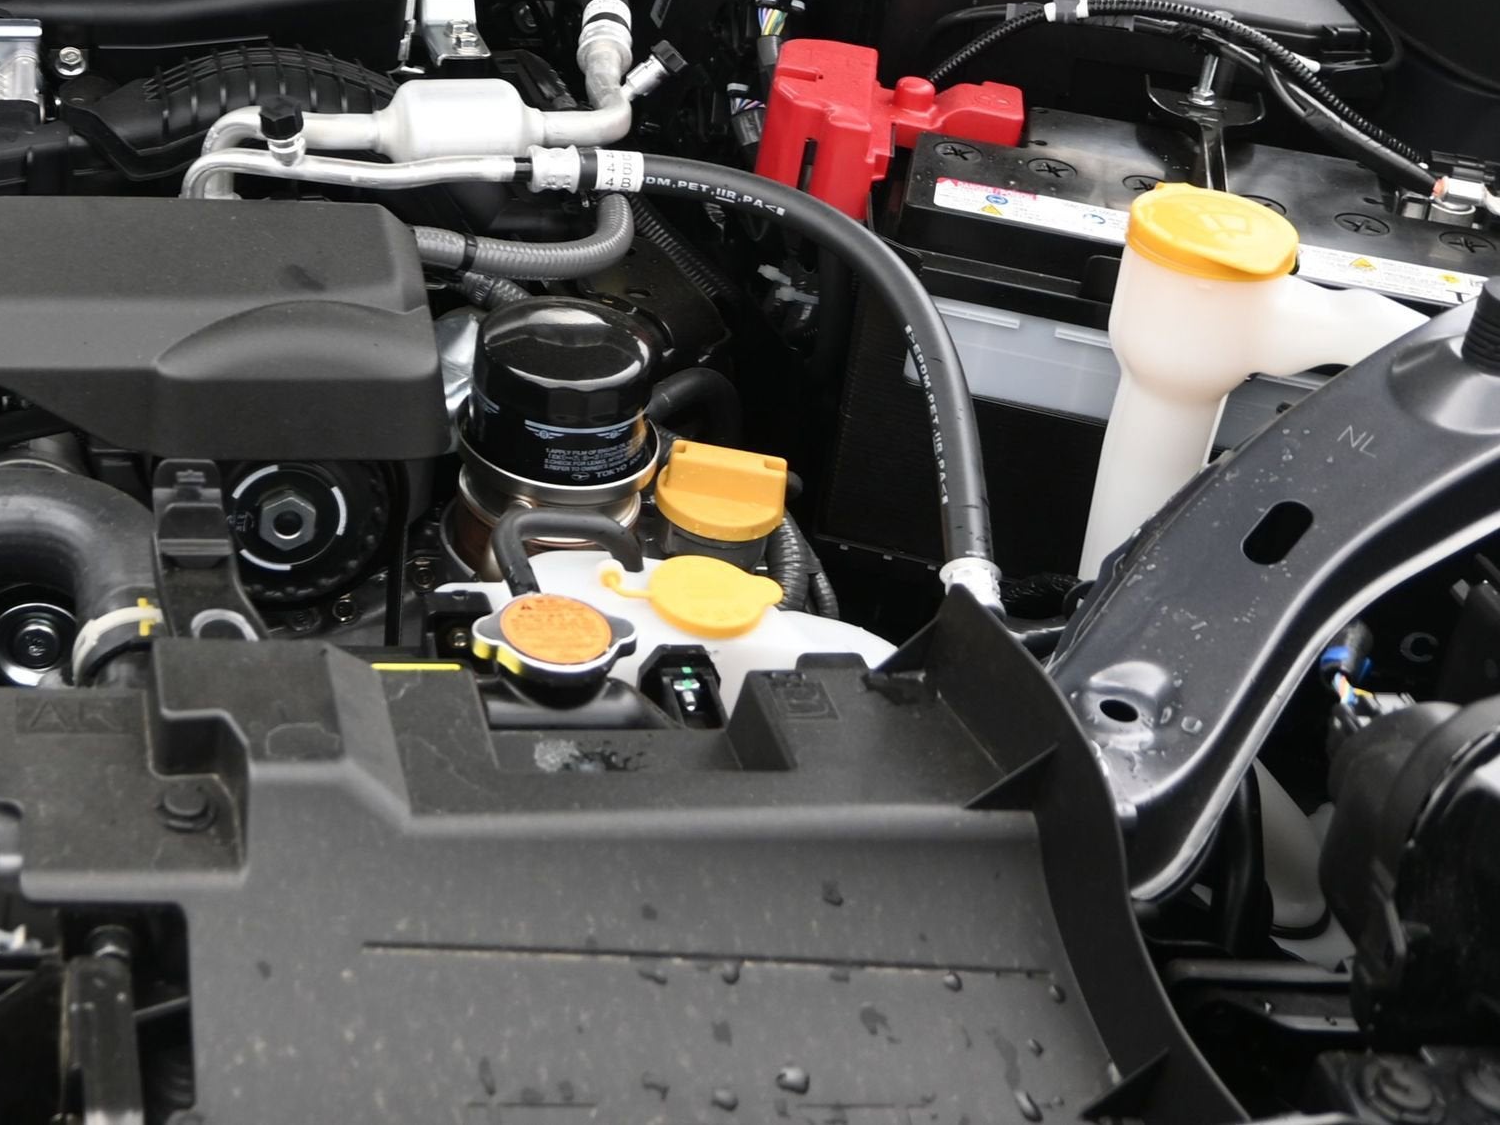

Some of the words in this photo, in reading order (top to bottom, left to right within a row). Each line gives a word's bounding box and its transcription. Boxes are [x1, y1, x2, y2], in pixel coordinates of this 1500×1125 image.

[604, 176, 615, 187] 4
[620, 177, 632, 188] B
[1336, 424, 1378, 460] NL
[595, 463, 628, 478] TOKYO
